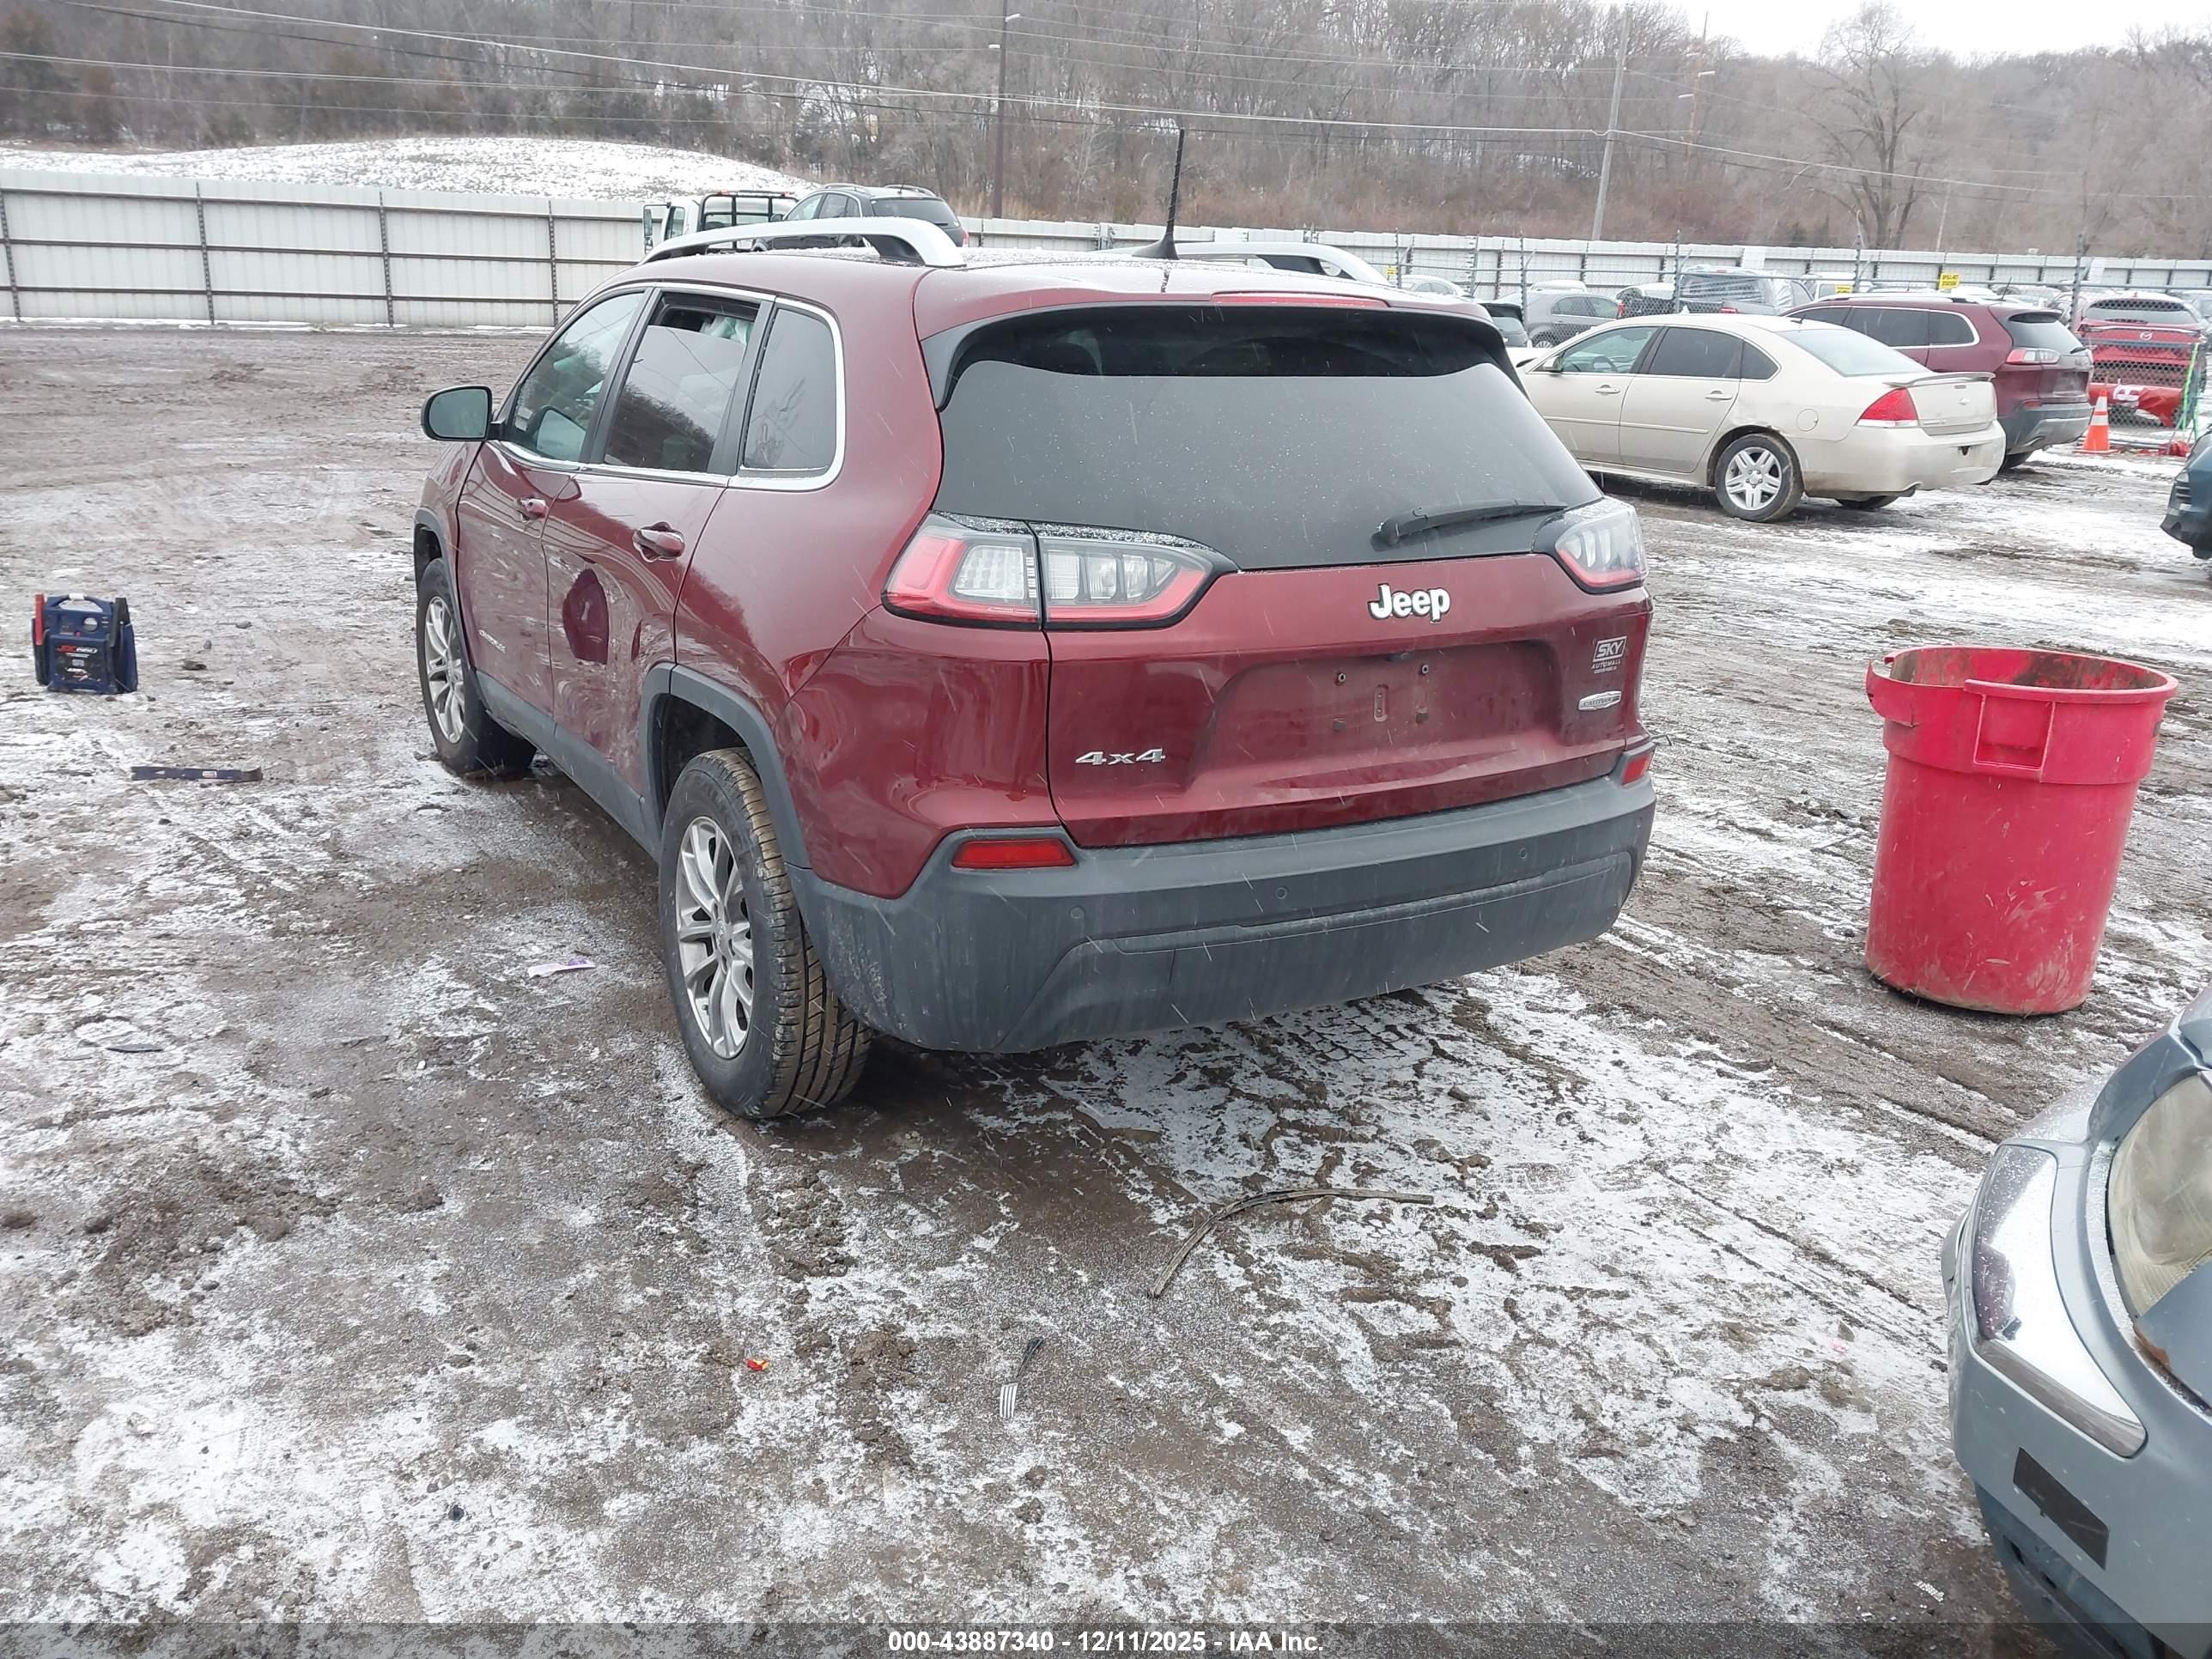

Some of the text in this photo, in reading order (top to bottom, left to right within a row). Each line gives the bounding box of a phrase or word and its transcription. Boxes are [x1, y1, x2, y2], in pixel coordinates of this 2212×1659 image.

[1367, 583, 1450, 623] Jeep
[1596, 640, 1624, 658] SKY
[1591, 659, 1621, 670] AUTOMALL
[1075, 747, 1166, 765] 4x4
